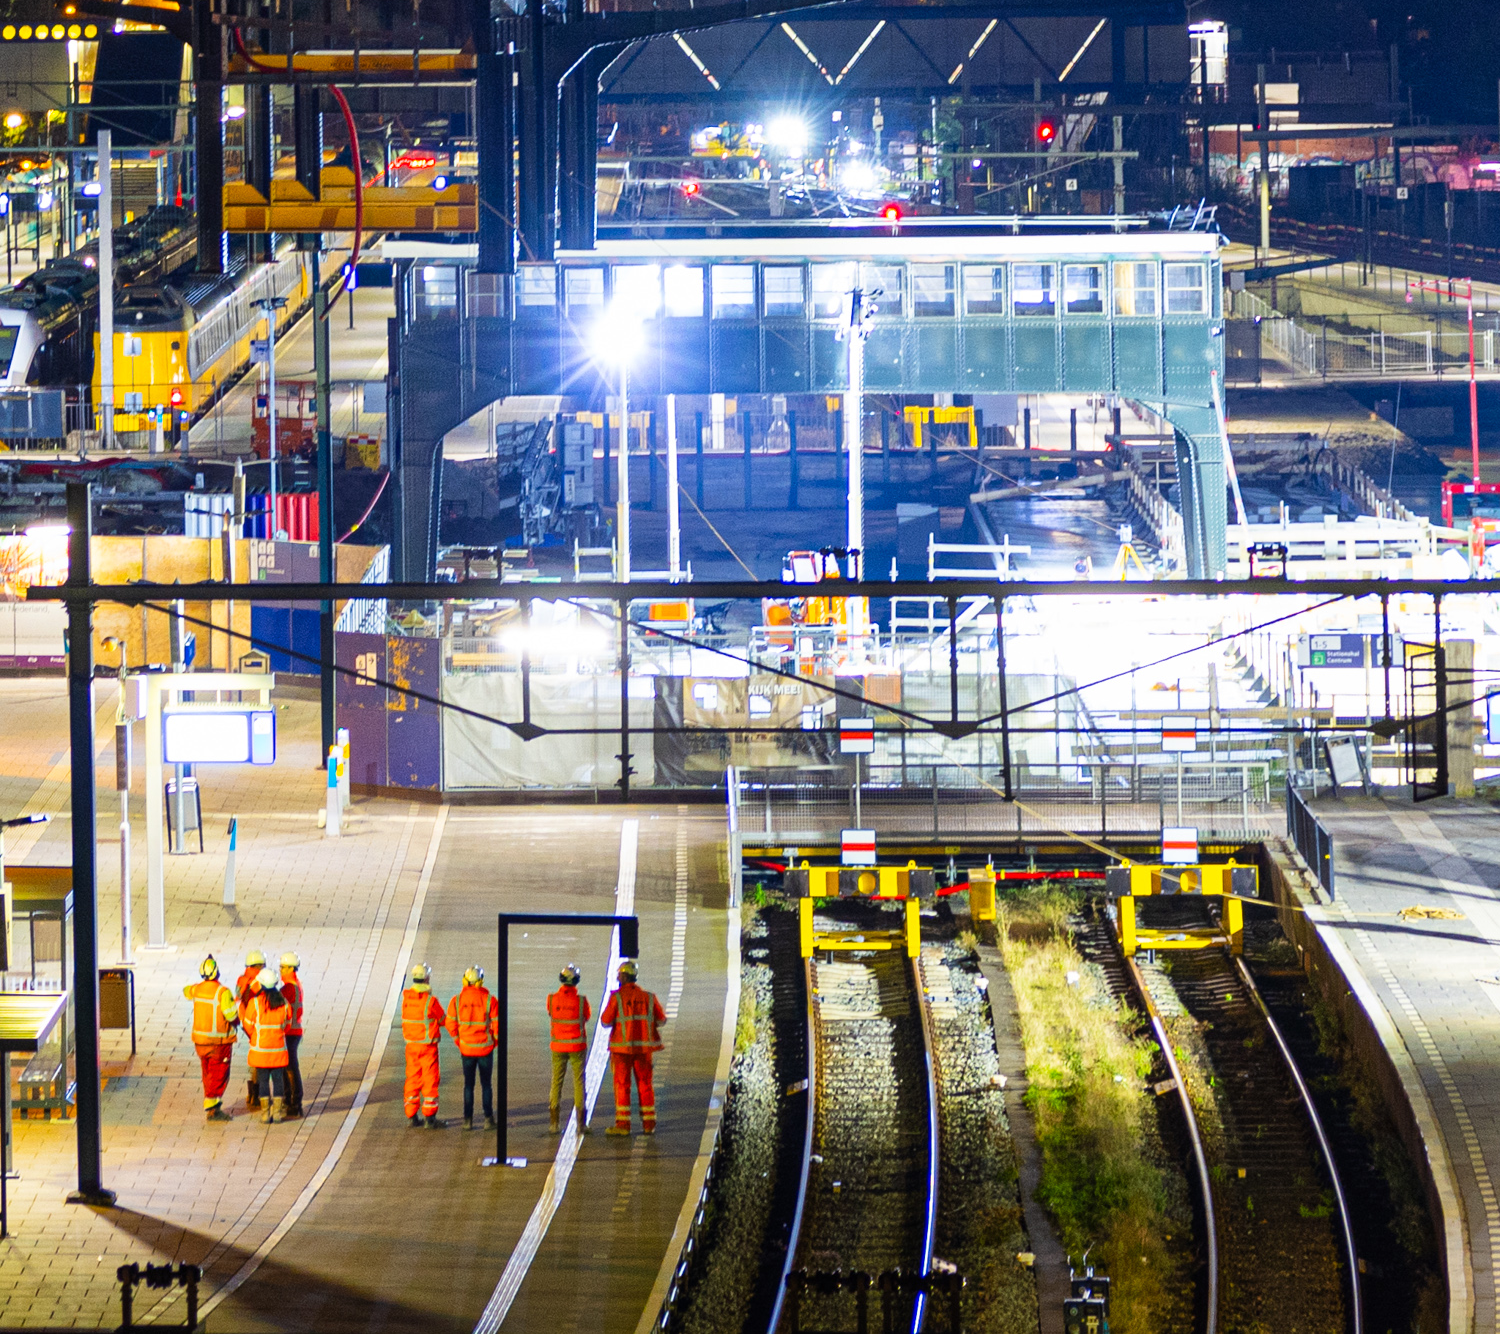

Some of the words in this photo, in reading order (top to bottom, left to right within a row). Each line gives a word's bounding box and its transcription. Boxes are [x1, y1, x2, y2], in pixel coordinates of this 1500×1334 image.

[1314, 640, 1328, 649] 1-5
[747, 684, 771, 696] KIJK
[773, 684, 802, 696] MEE!
